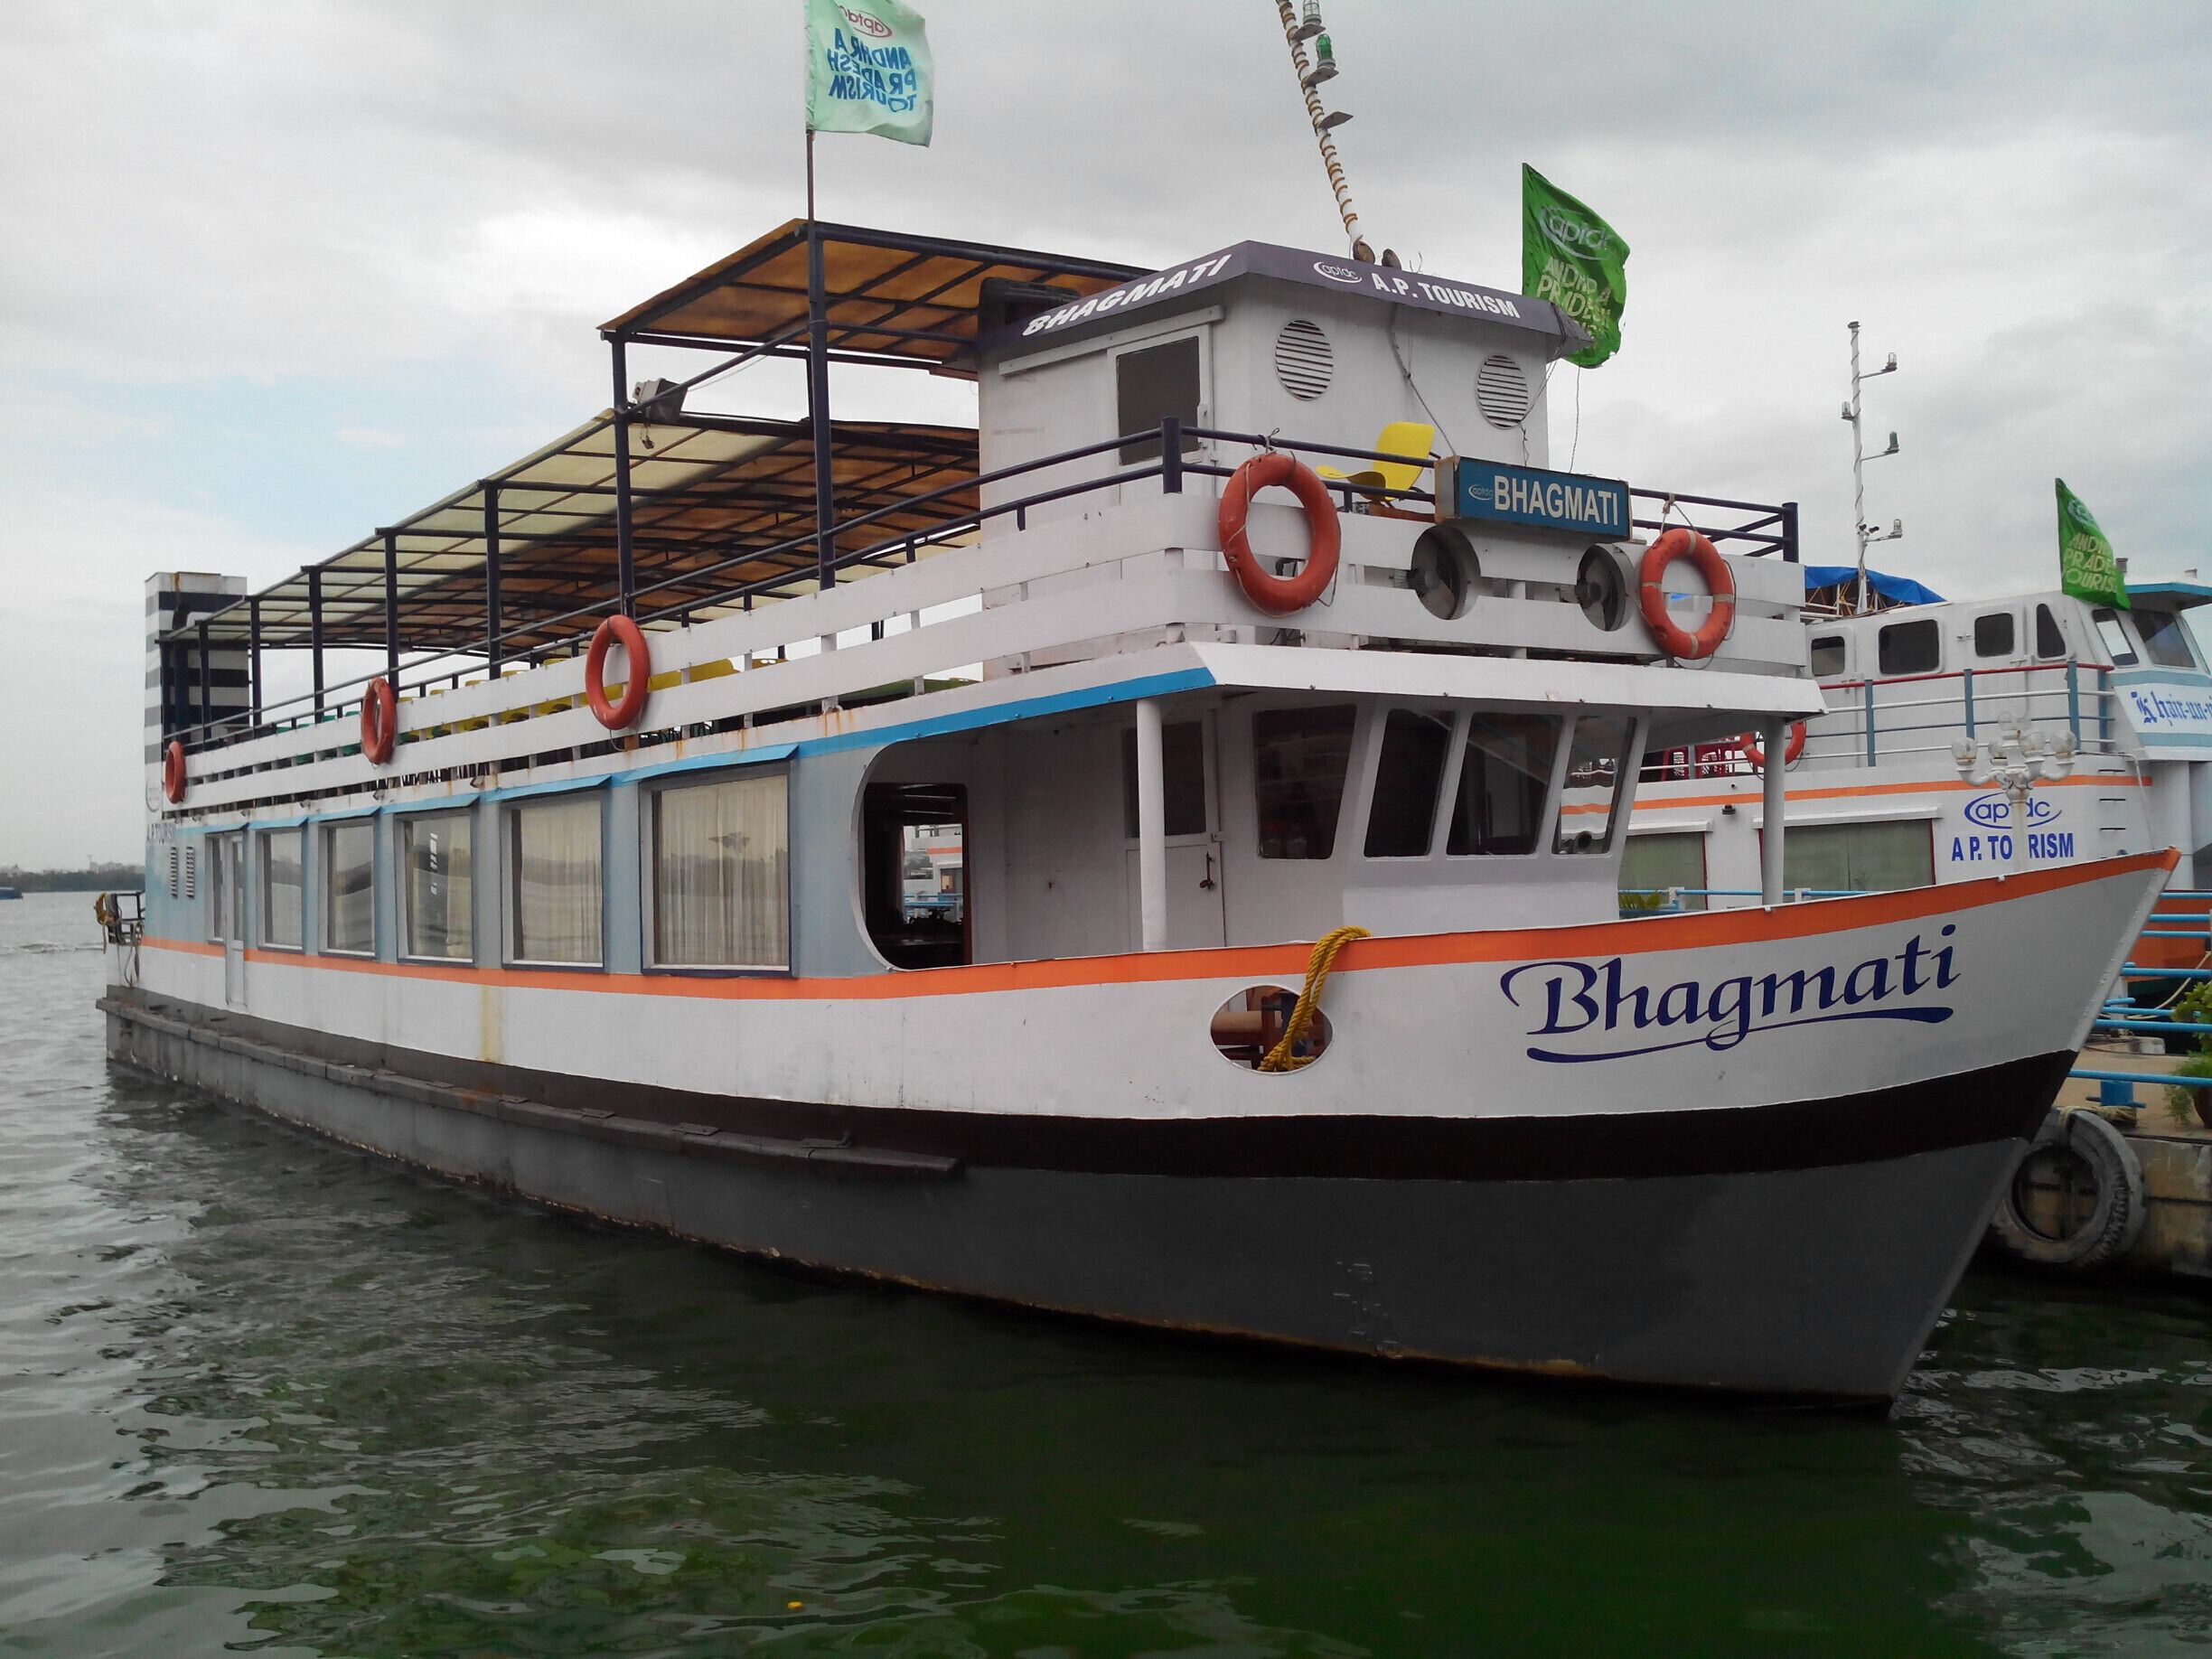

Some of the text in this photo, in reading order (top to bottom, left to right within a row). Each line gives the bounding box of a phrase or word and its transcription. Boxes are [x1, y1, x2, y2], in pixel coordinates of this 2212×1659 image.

[1022, 254, 1233, 336] BHAGMATI
[1371, 273, 1418, 298] A.P.
[1417, 282, 1521, 318] TOURISM
[1494, 475, 1618, 526] BHAGMATI
[1988, 832, 2075, 860] TORISM
[1500, 923, 1962, 1051] Bhagmati
